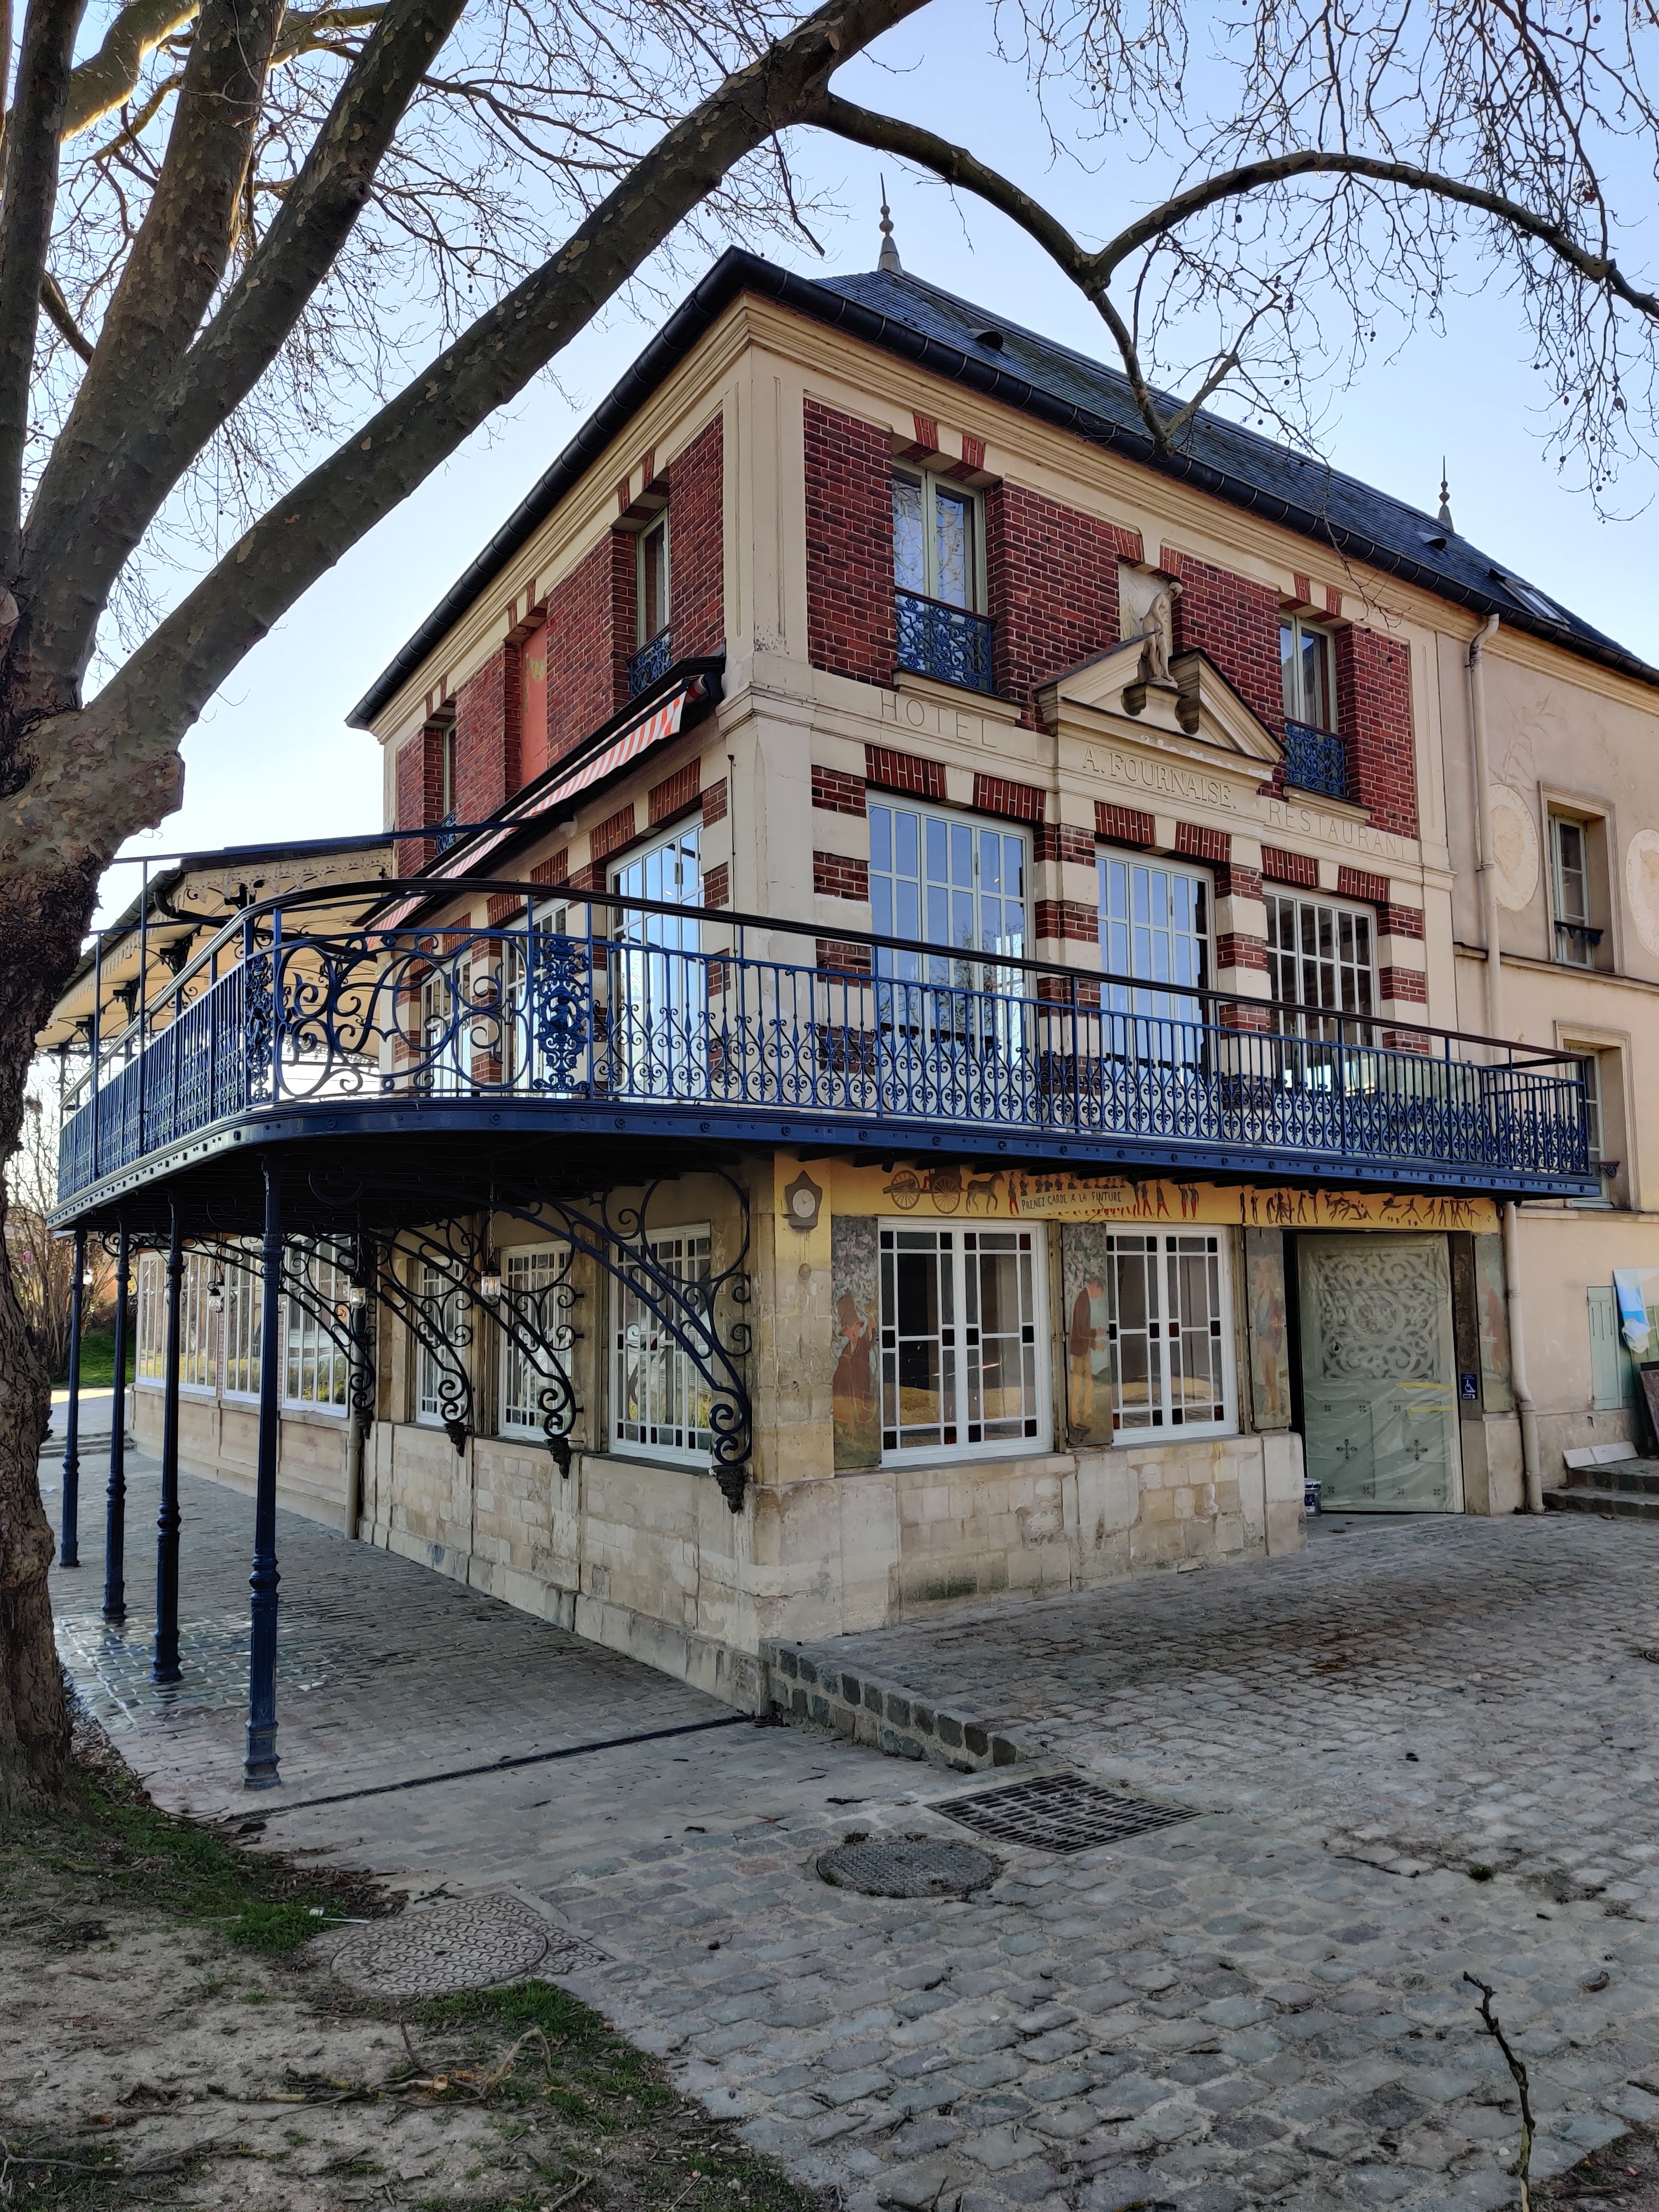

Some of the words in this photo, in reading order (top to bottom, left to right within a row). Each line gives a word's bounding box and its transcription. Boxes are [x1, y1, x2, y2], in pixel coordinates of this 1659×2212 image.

[880, 690, 998, 748] HOTEL
[1083, 747, 1106, 774] A.
[1110, 752, 1237, 809] FOURNAISE.
[1269, 800, 1408, 859] RESTAURANT
[1021, 1197, 1045, 1212] PRENEZ
[1078, 1193, 1087, 1202] LA
